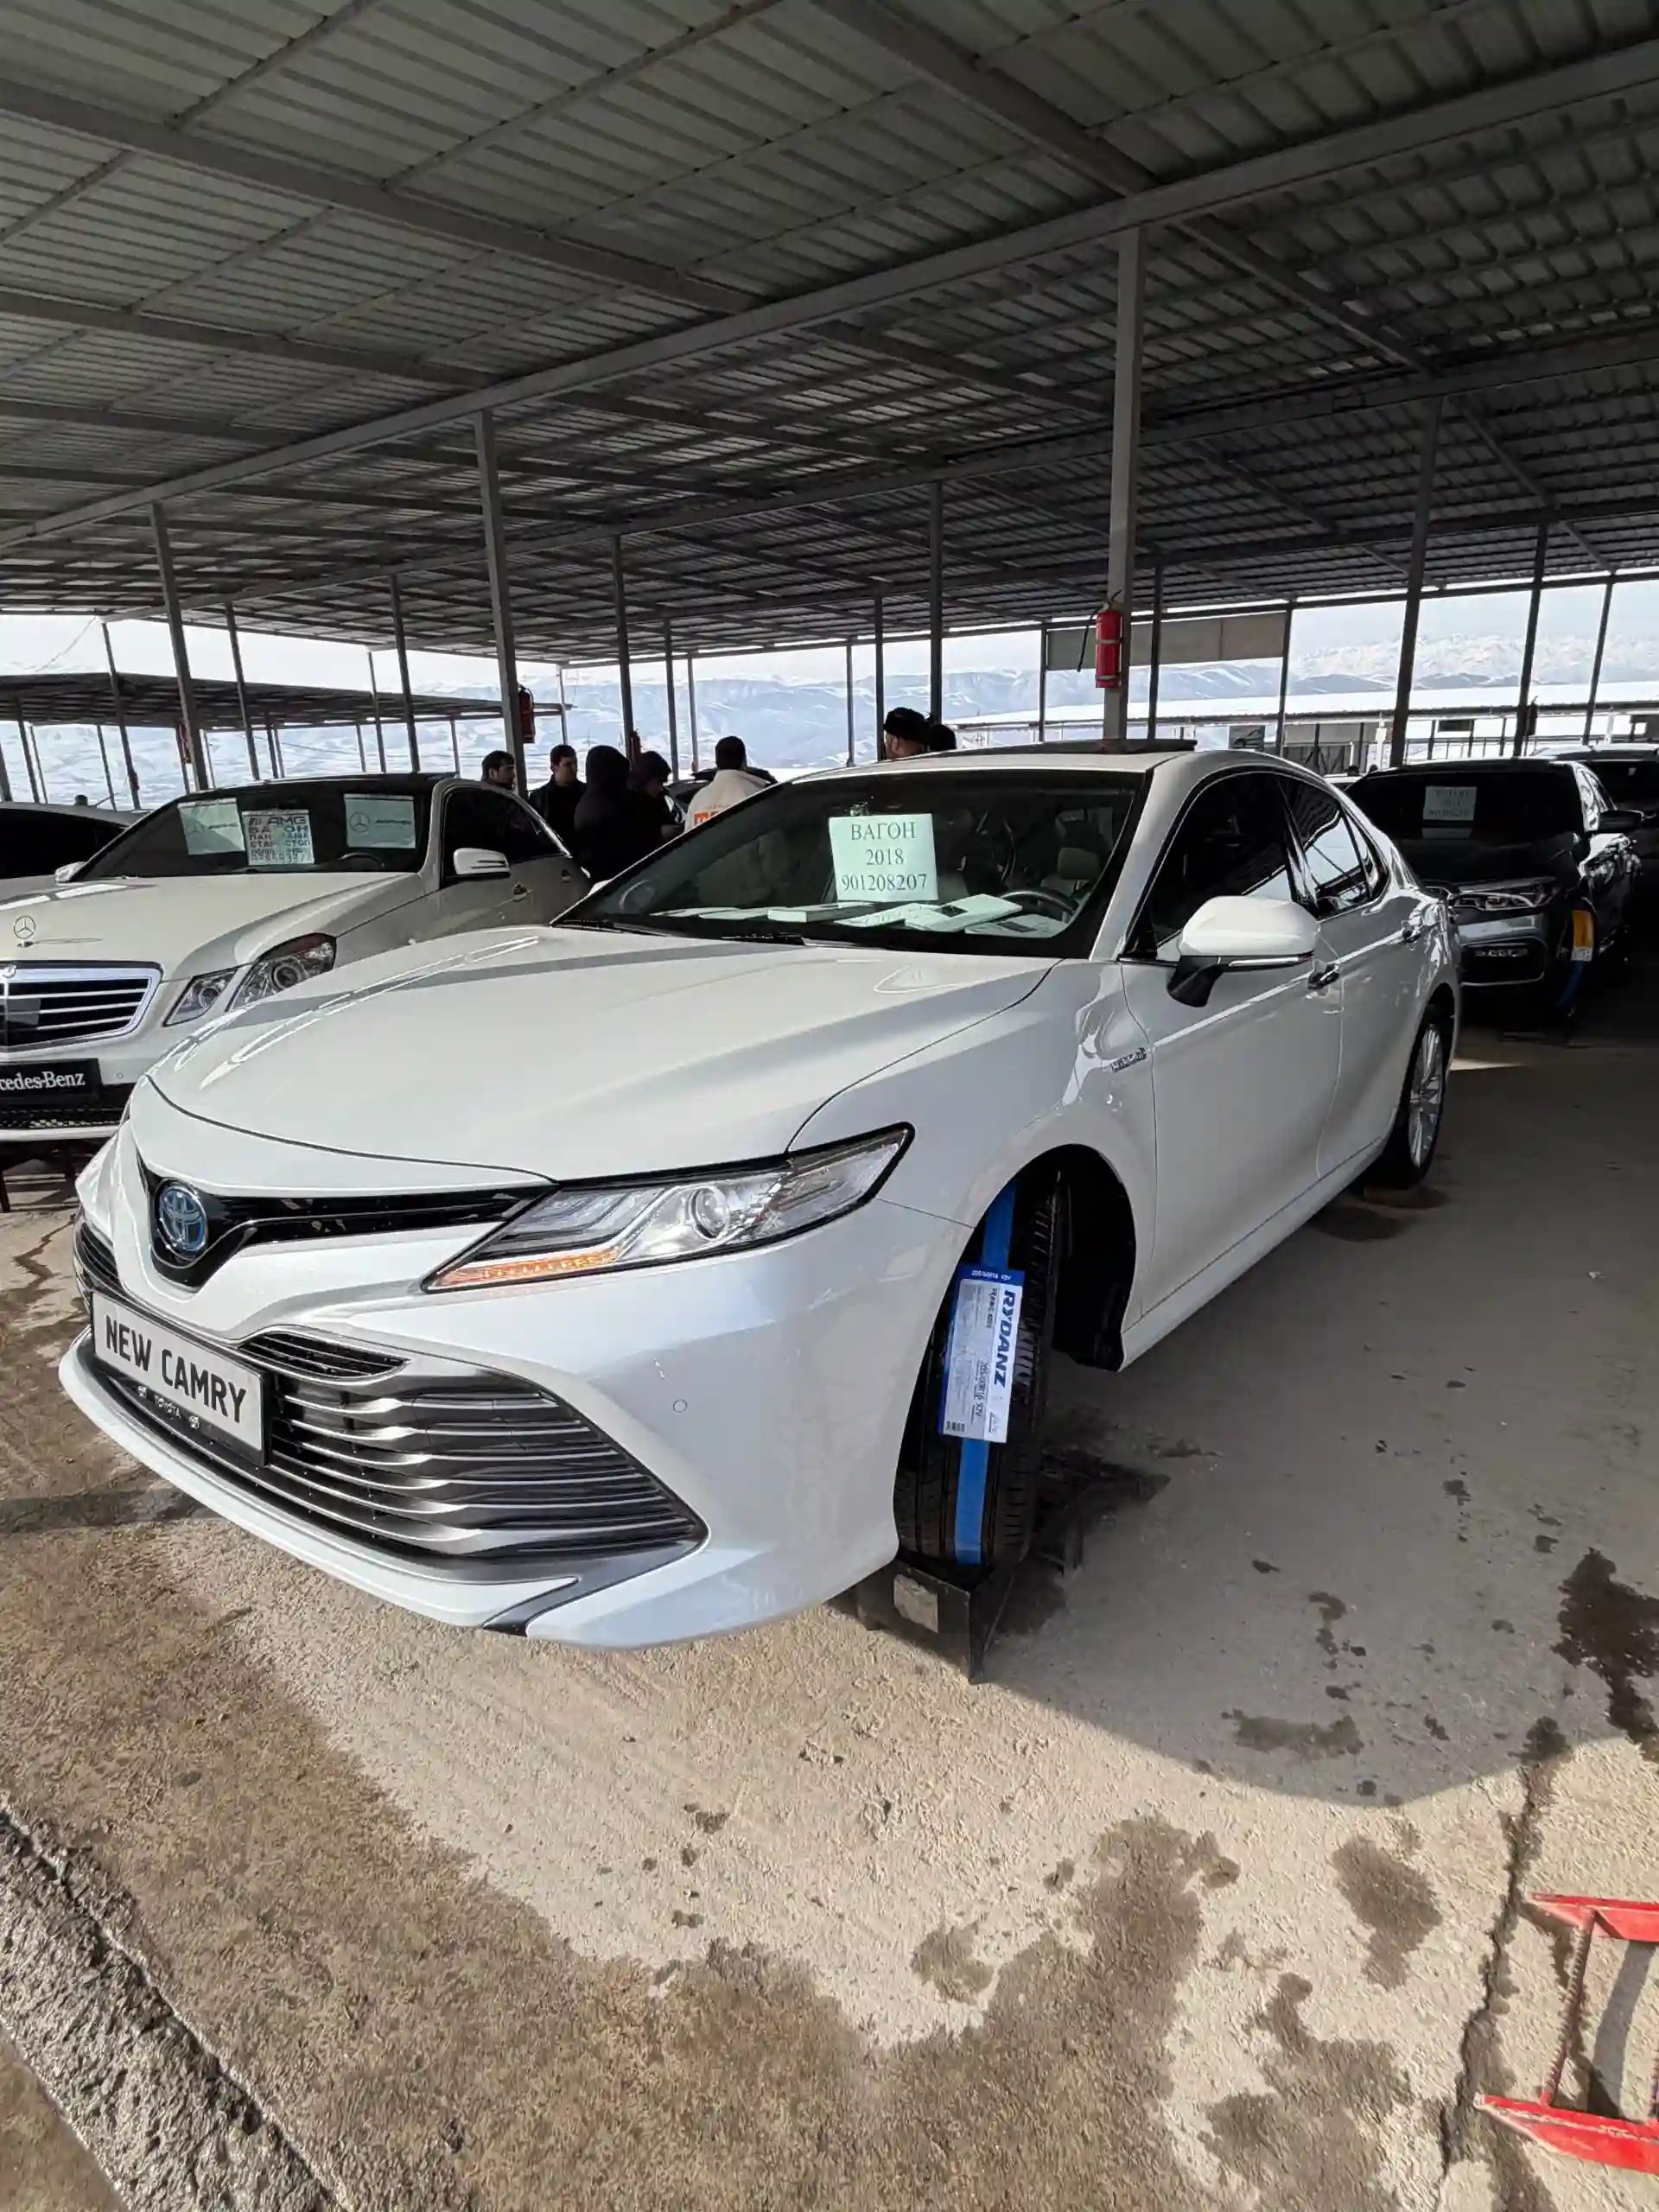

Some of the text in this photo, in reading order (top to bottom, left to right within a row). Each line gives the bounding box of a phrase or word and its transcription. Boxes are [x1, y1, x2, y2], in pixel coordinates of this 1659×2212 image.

[851, 822, 917, 840] ВАГОН
[865, 848, 905, 866] 2018
[842, 874, 927, 892] 901208207
[994, 1289, 1016, 1388] RYDANZ
[105, 1314, 247, 1424] NEW CAMRY
